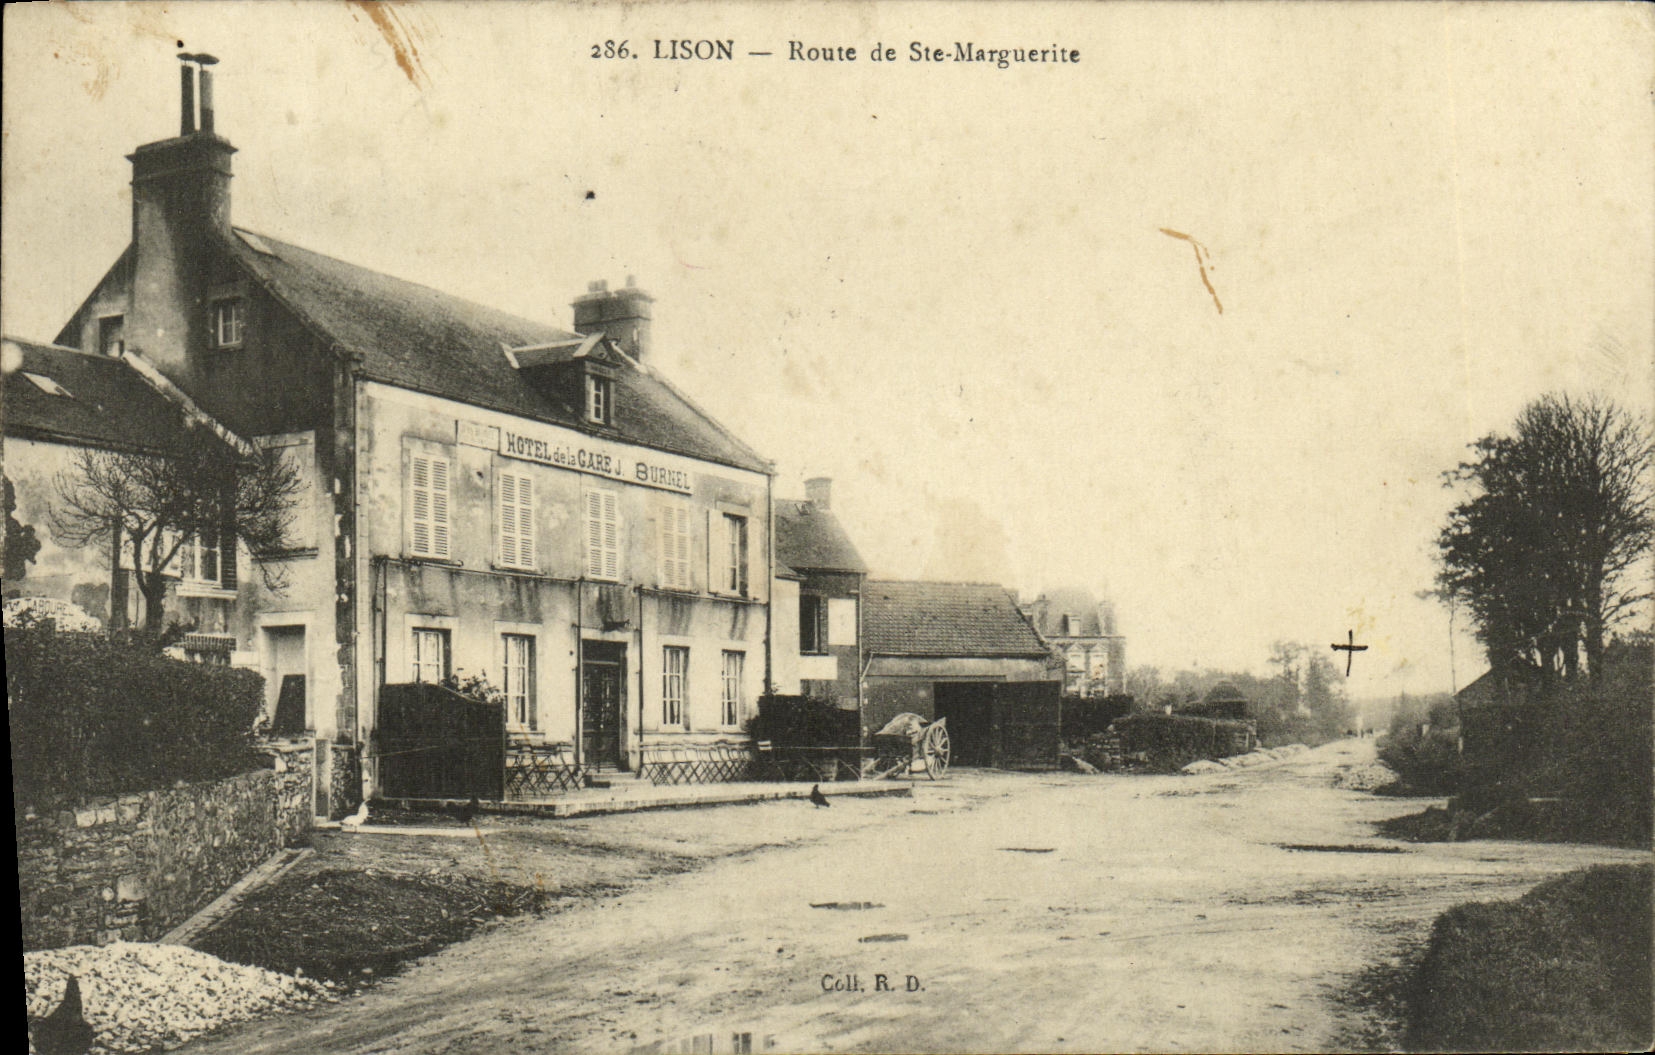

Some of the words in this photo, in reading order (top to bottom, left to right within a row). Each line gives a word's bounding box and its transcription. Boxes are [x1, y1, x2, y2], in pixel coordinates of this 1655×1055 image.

[553, 446, 566, 463] de
[566, 446, 577, 466] la
[577, 448, 612, 474] GARE
